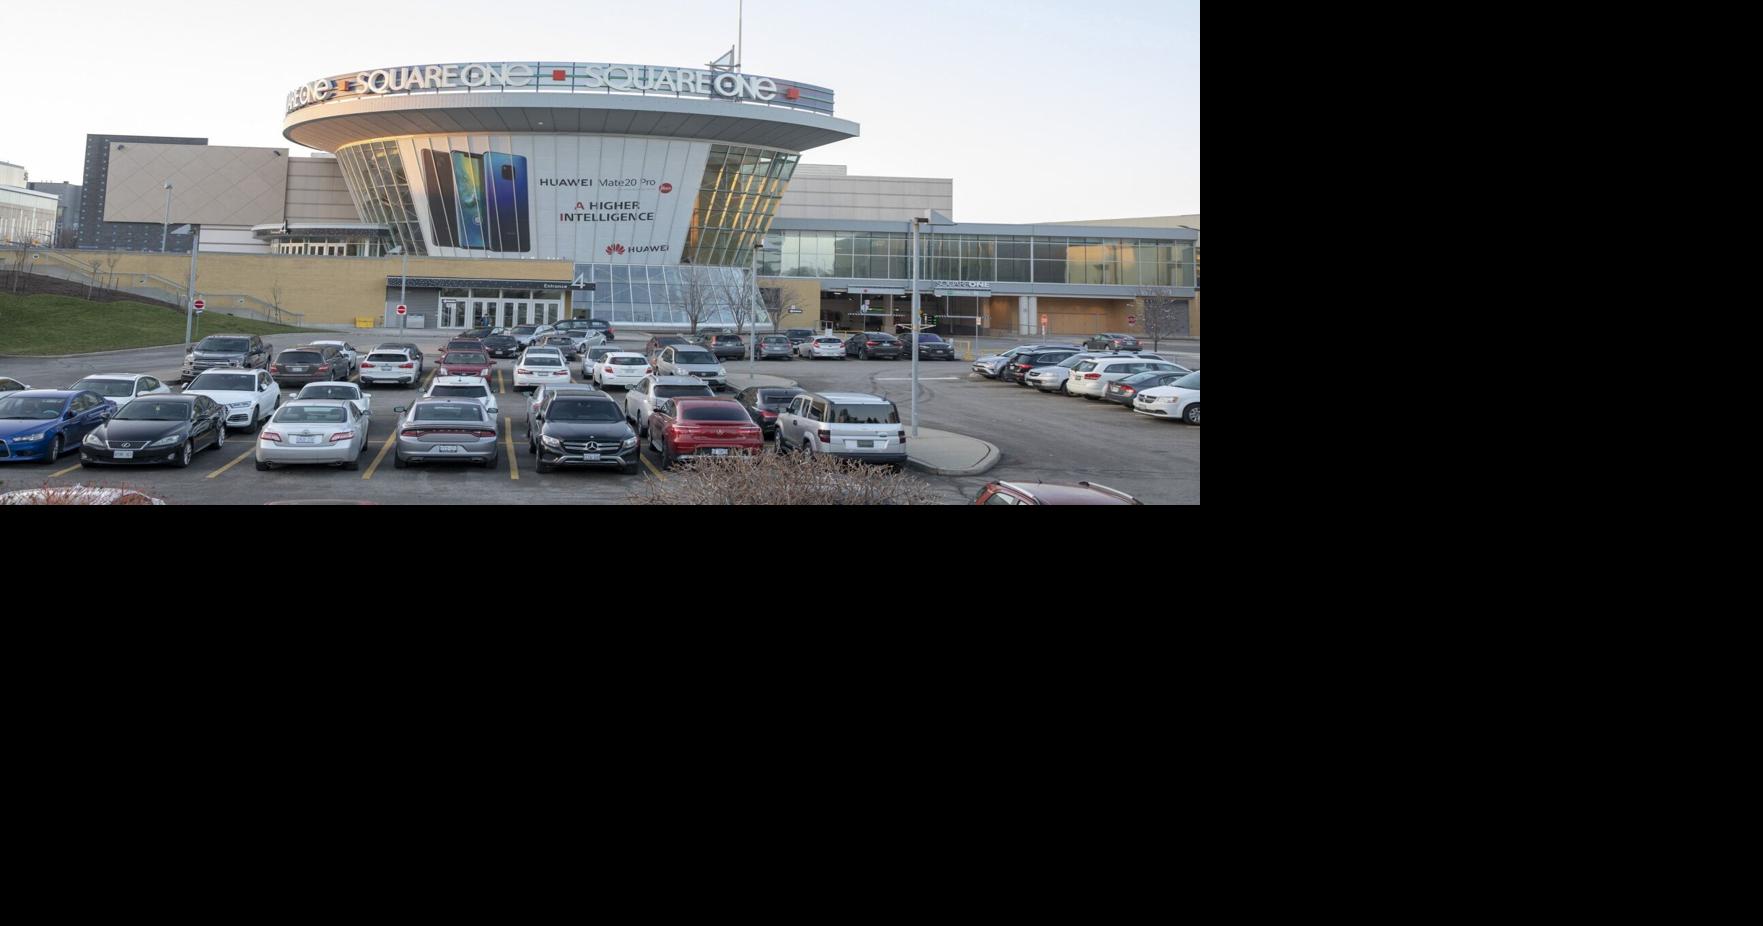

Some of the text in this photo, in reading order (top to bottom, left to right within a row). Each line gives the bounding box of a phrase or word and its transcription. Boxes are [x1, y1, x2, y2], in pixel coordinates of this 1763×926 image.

[356, 65, 458, 94] SQUARE
[585, 66, 712, 92] SQUARE
[539, 178, 593, 187] HUAWEI
[641, 178, 656, 186] Pro
[574, 201, 640, 210] A HIGHER
[560, 212, 654, 222] INTELLIGENCE
[627, 244, 670, 253] HUAWEI
[571, 272, 586, 289] 4
